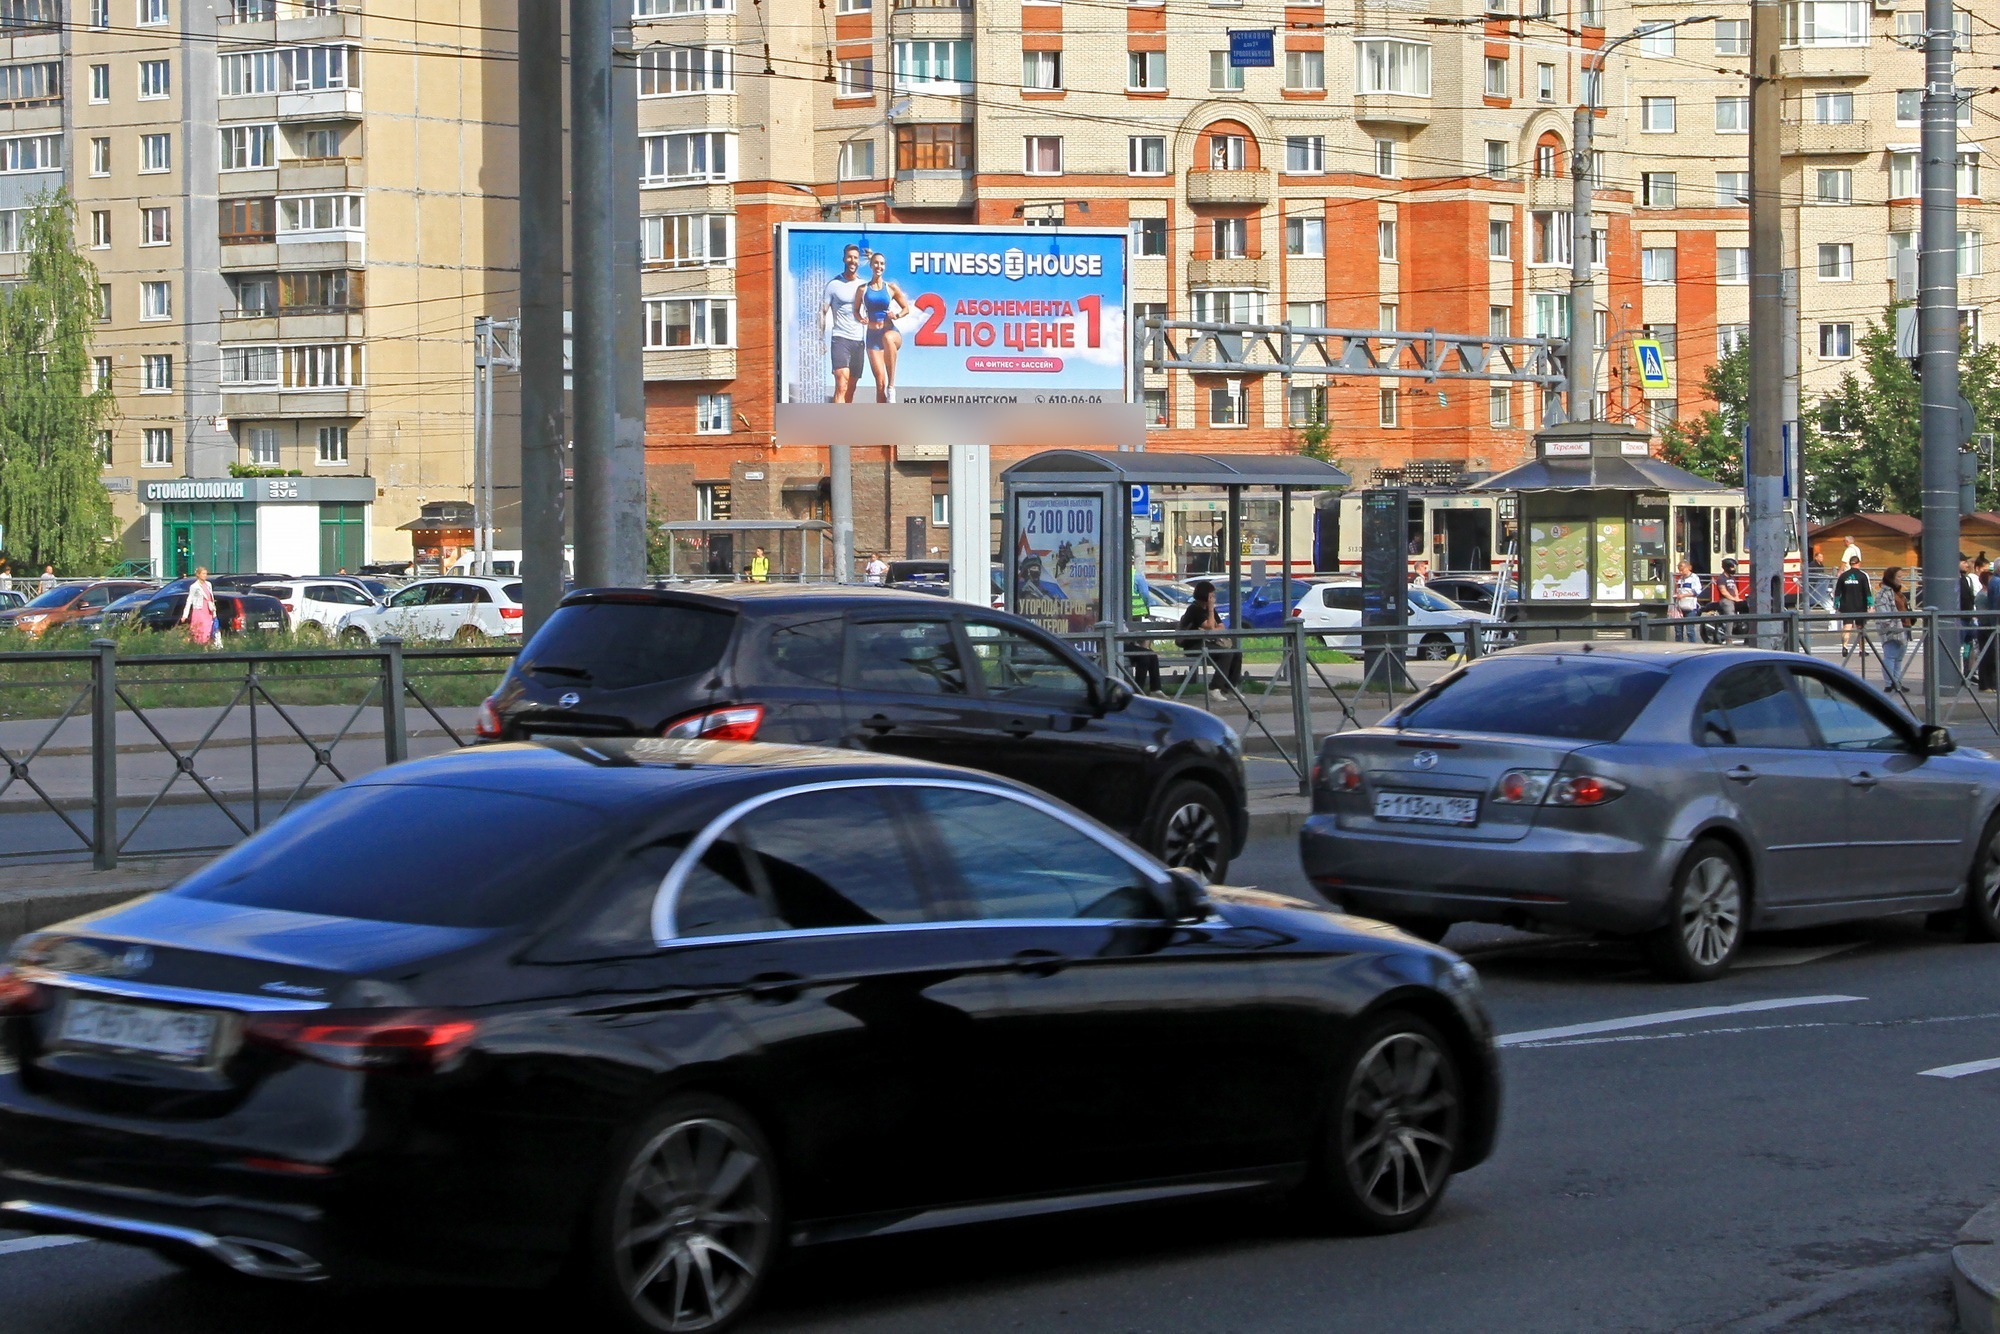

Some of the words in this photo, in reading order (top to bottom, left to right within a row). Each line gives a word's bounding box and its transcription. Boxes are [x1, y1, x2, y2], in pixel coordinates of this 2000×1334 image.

[909, 252, 1002, 276] FITNESS
[1027, 254, 1102, 277] HOUSE
[954, 299, 1074, 317] АБОНЕМЕНТА
[914, 293, 947, 347] 2
[954, 321, 996, 347] ПО
[1003, 323, 1075, 352] ЦЕНЕ
[1021, 361, 1054, 369] БАССЕЙН
[919, 395, 1018, 403] КОМЕНДАНТСКОМ
[1552, 443, 1584, 452] Теремок
[269, 489, 298, 498] ЗУБ
[1027, 510, 1036, 534] 2
[1040, 510, 1063, 534] 100
[1067, 510, 1093, 534] 000
[1242, 545, 1251, 554] 55
[1551, 590, 1580, 598] Теремок
